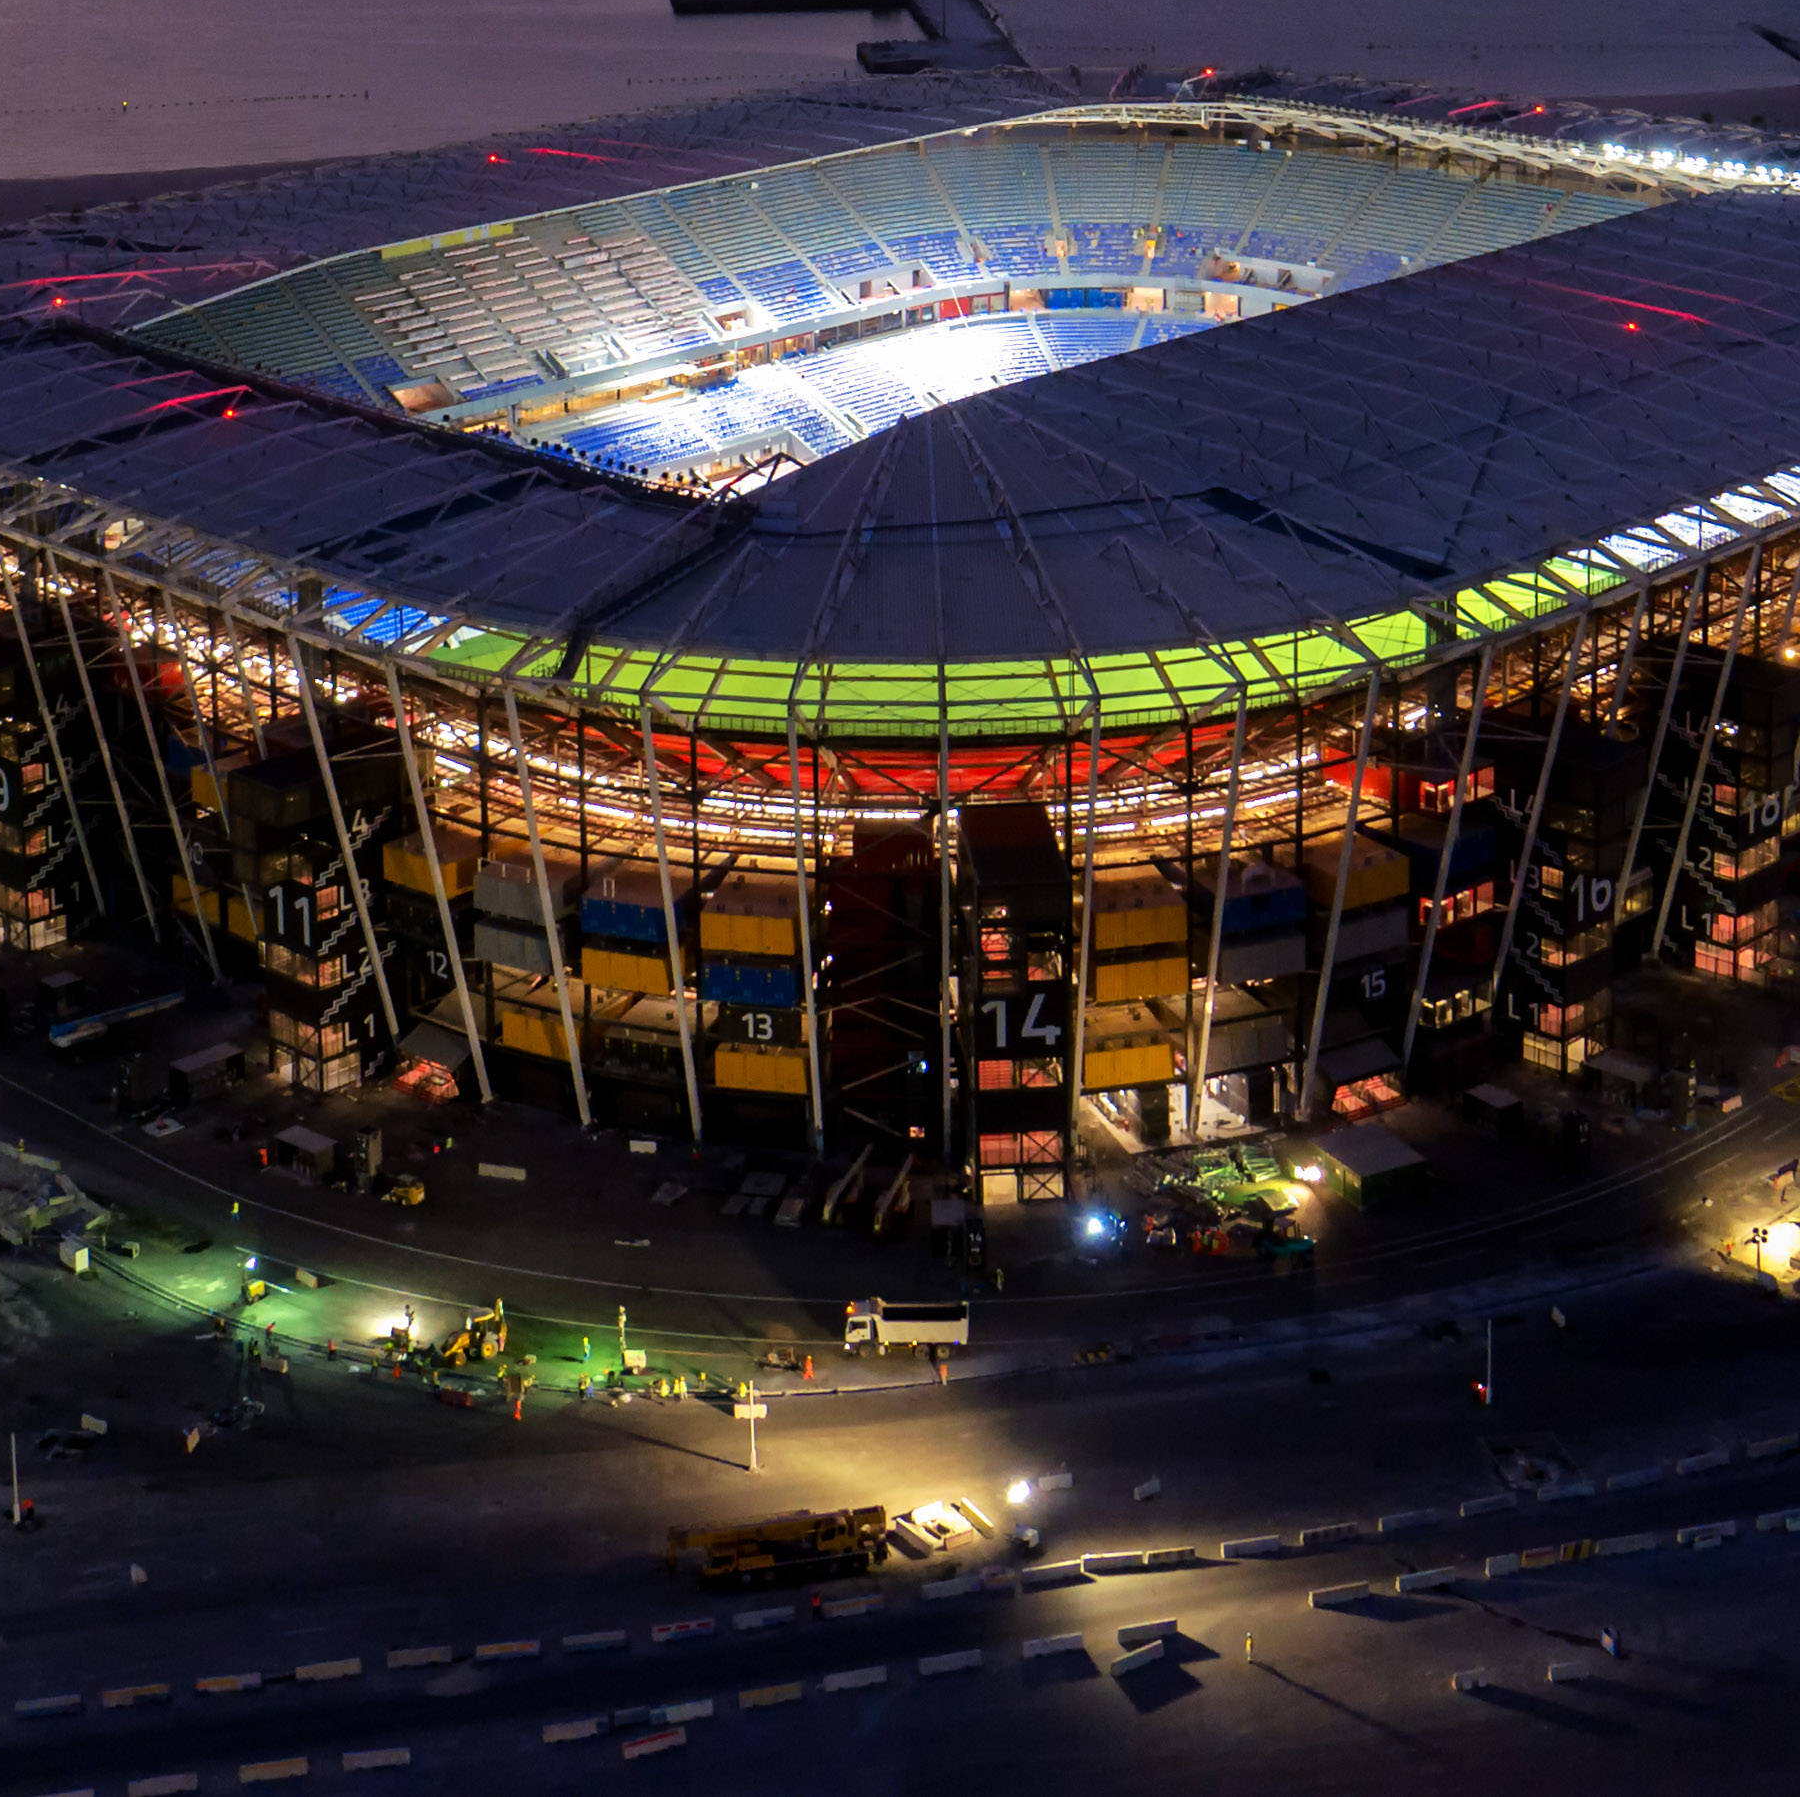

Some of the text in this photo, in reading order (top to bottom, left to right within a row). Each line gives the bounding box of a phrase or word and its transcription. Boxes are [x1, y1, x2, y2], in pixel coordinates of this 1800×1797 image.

[268, 885, 311, 947] 11
[425, 950, 449, 979] 12
[1360, 969, 1387, 999] 15
[741, 1012, 775, 1042] 13
[980, 992, 1063, 1048] 14
